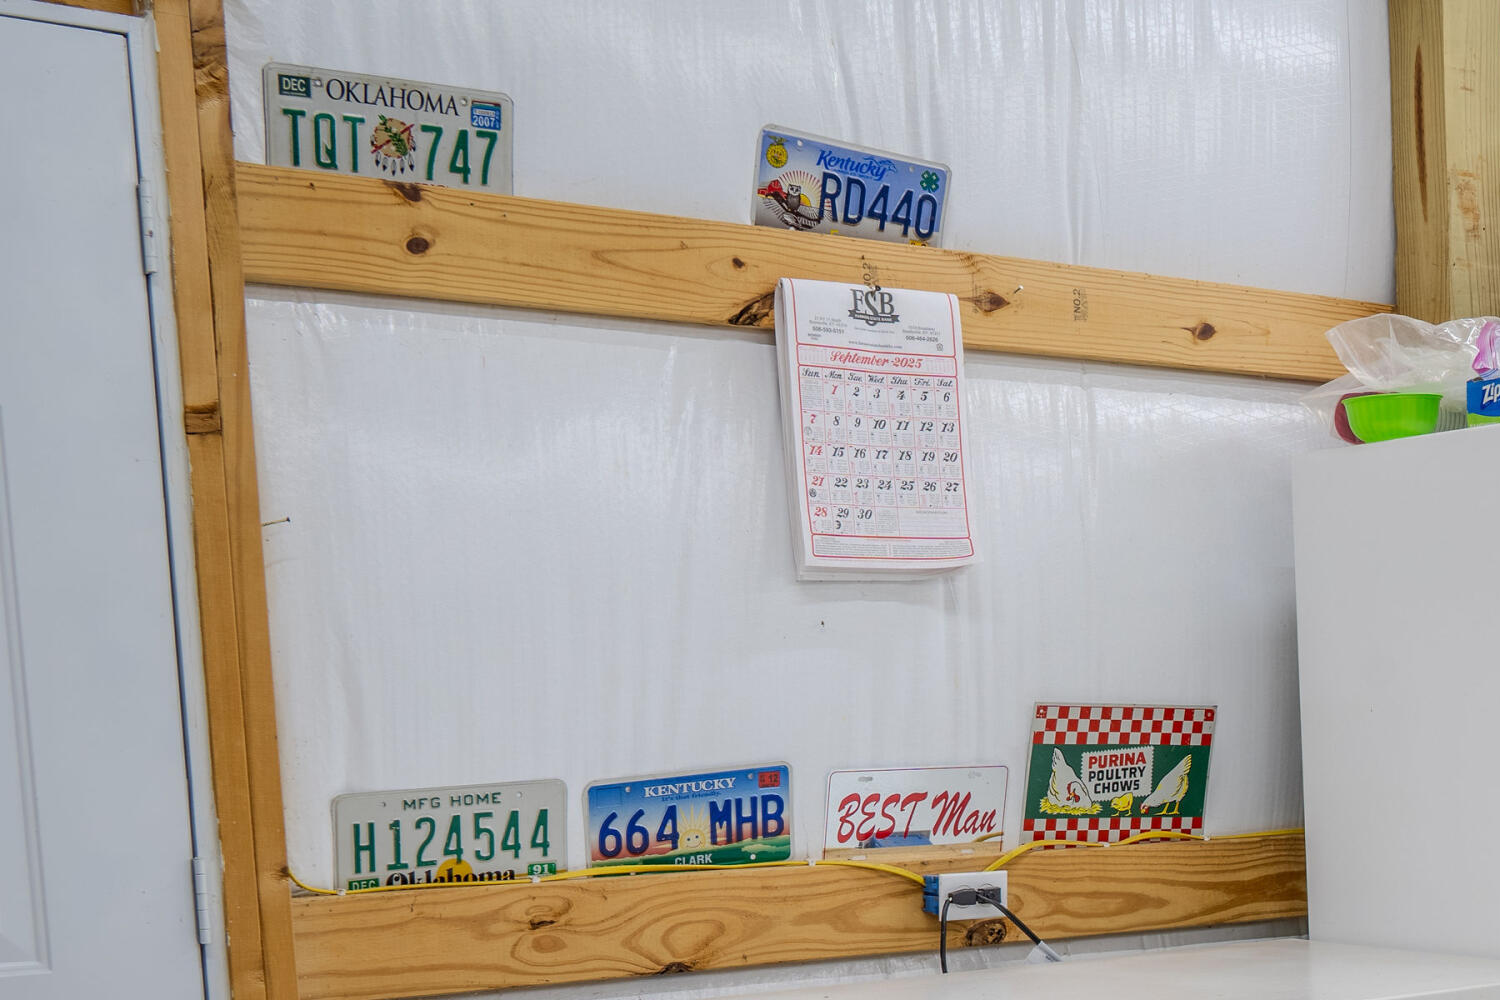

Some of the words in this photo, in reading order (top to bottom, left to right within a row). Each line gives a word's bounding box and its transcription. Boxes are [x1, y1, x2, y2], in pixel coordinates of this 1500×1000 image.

[282, 77, 306, 92] DEC
[326, 78, 459, 116] OKLAHOMA
[473, 115, 495, 128] 2007
[282, 108, 365, 173] TQT
[421, 125, 498, 185] 747
[816, 150, 886, 181] Kentucky
[819, 172, 937, 239] RD440
[850, 289, 894, 326] FSB
[832, 385, 838, 394] 1
[853, 387, 860, 396] 2
[874, 388, 880, 398] 3
[897, 390, 905, 400] 4
[920, 391, 928, 401] 5
[944, 392, 951, 402] 6
[810, 414, 816, 423] 7
[833, 416, 840, 426] 8
[855, 417, 861, 427] 9
[873, 419, 887, 429] 10
[896, 420, 910, 430] 11
[920, 421, 933, 431] 12
[941, 423, 954, 433] 13
[809, 445, 822, 455] 14
[832, 446, 844, 457] 15
[854, 447, 866, 458] 16
[875, 449, 888, 460] 17
[898, 450, 912, 460] 18
[921, 451, 935, 461] 19
[943, 452, 958, 462] 20
[811, 476, 824, 486] 21
[834, 477, 848, 487] 22
[856, 478, 869, 489] 23
[877, 480, 892, 490] 24
[900, 480, 914, 491] 25
[923, 481, 936, 492] 26
[945, 482, 959, 492] 27
[814, 507, 827, 517] 28
[837, 507, 849, 518] 29
[857, 509, 873, 519] 30
[1088, 752, 1147, 769] PURINA
[1088, 766, 1146, 782] POULTRY
[643, 777, 736, 797] KENTUCKY
[1094, 779, 1140, 794] CHOWS
[403, 797, 441, 811] MFG
[450, 792, 501, 807] HOME
[837, 791, 928, 843] BEST
[931, 790, 996, 837] Man
[598, 804, 680, 857] 664
[709, 794, 785, 846] MHB
[353, 809, 550, 874] H124544
[674, 854, 712, 865] CLARK
[386, 868, 515, 886] Oklahoma
[533, 864, 549, 875] 91
[352, 880, 376, 890] DEC
